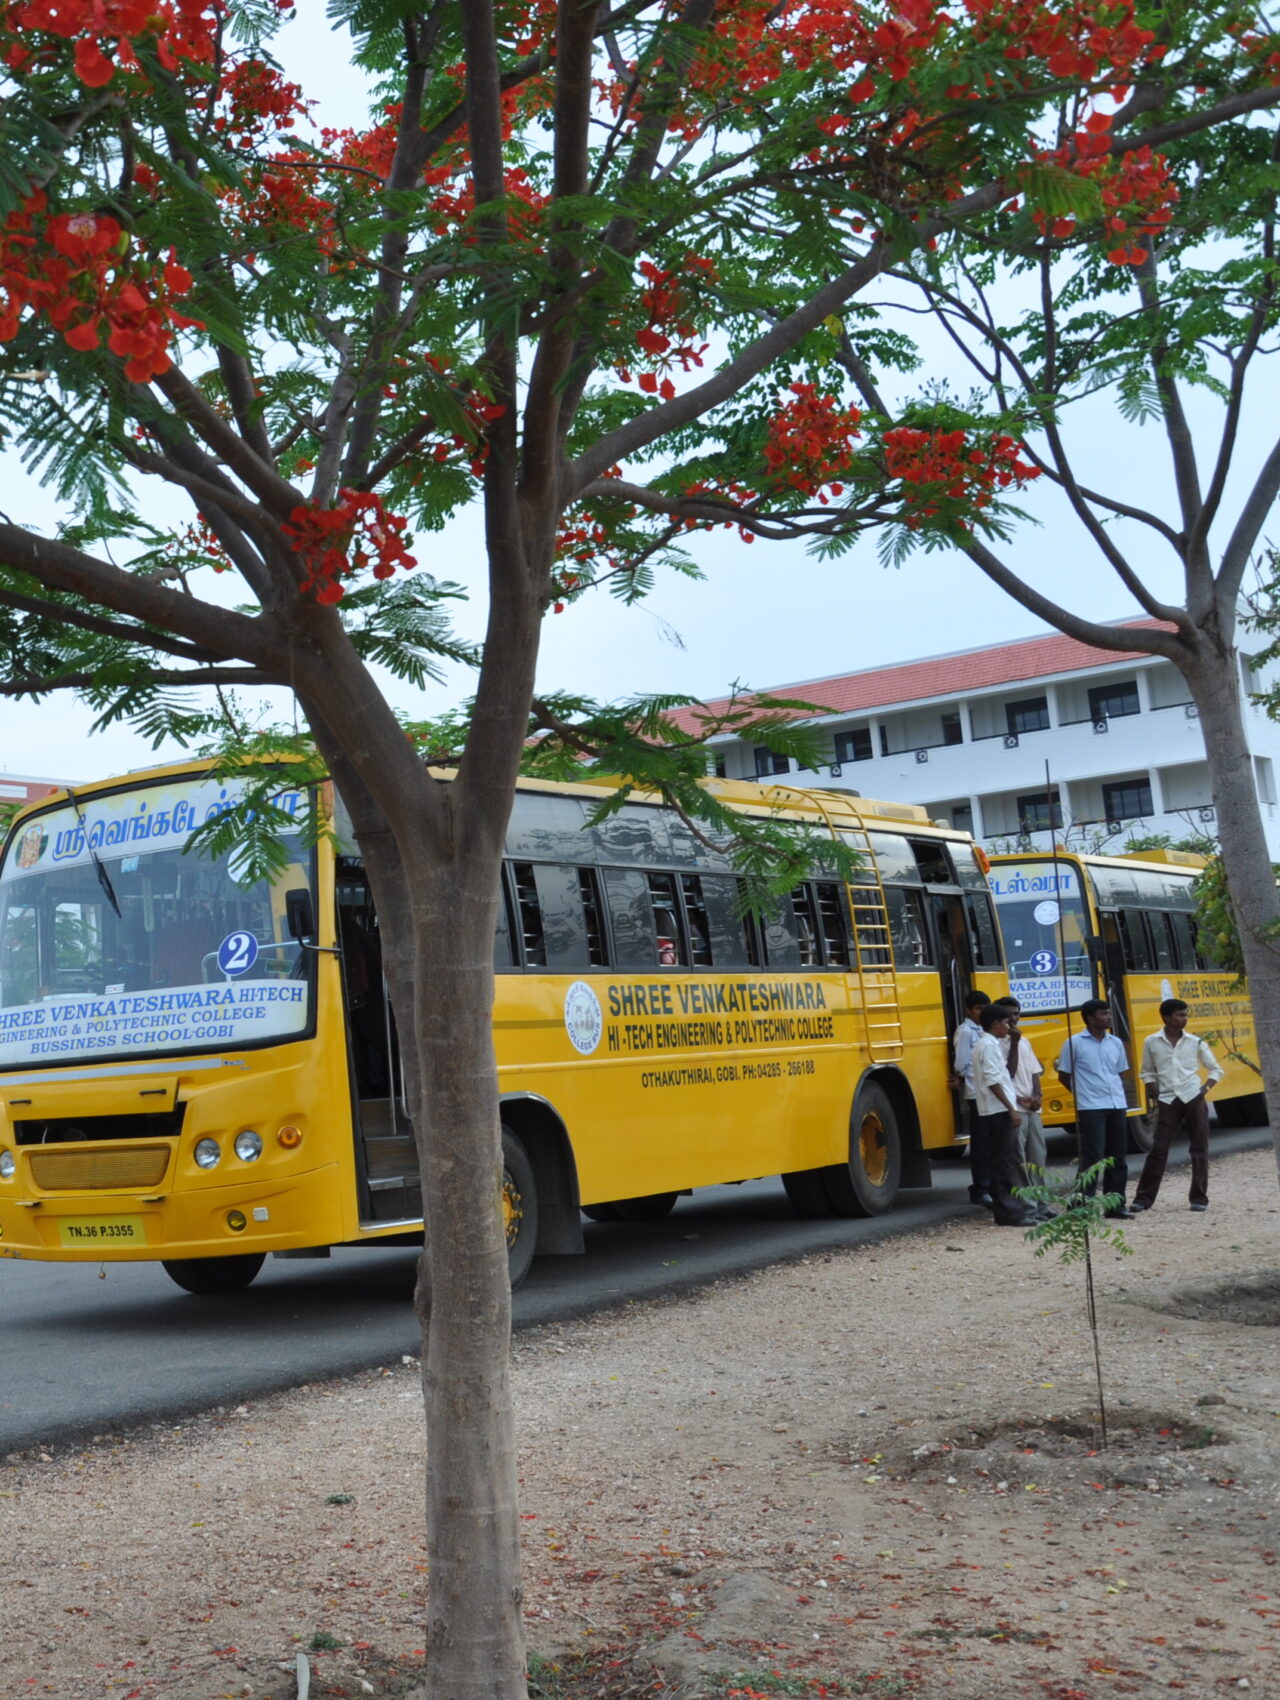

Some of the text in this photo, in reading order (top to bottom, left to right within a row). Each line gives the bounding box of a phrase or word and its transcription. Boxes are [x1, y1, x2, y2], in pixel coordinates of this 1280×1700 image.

[224, 933, 251, 970] 2
[1035, 952, 1052, 973] 3
[51, 988, 235, 1021] VENKATESHWARA
[608, 984, 674, 1017] SHREE
[677, 982, 827, 1015] VENKATESHWARA
[71, 1024, 82, 1035] &
[86, 1013, 187, 1033] POLYTECHNIC
[191, 1006, 266, 1023] COLLEGE
[656, 1021, 723, 1049] ENGINEERING
[726, 1021, 734, 1044] &
[735, 1017, 796, 1044] POLYTECHNIC
[797, 1016, 834, 1039] COLLEGE
[30, 1035, 117, 1054] BUSSINESS
[787, 1059, 815, 1076] 266188
[68, 1224, 134, 1238] TN.36 P.3355
